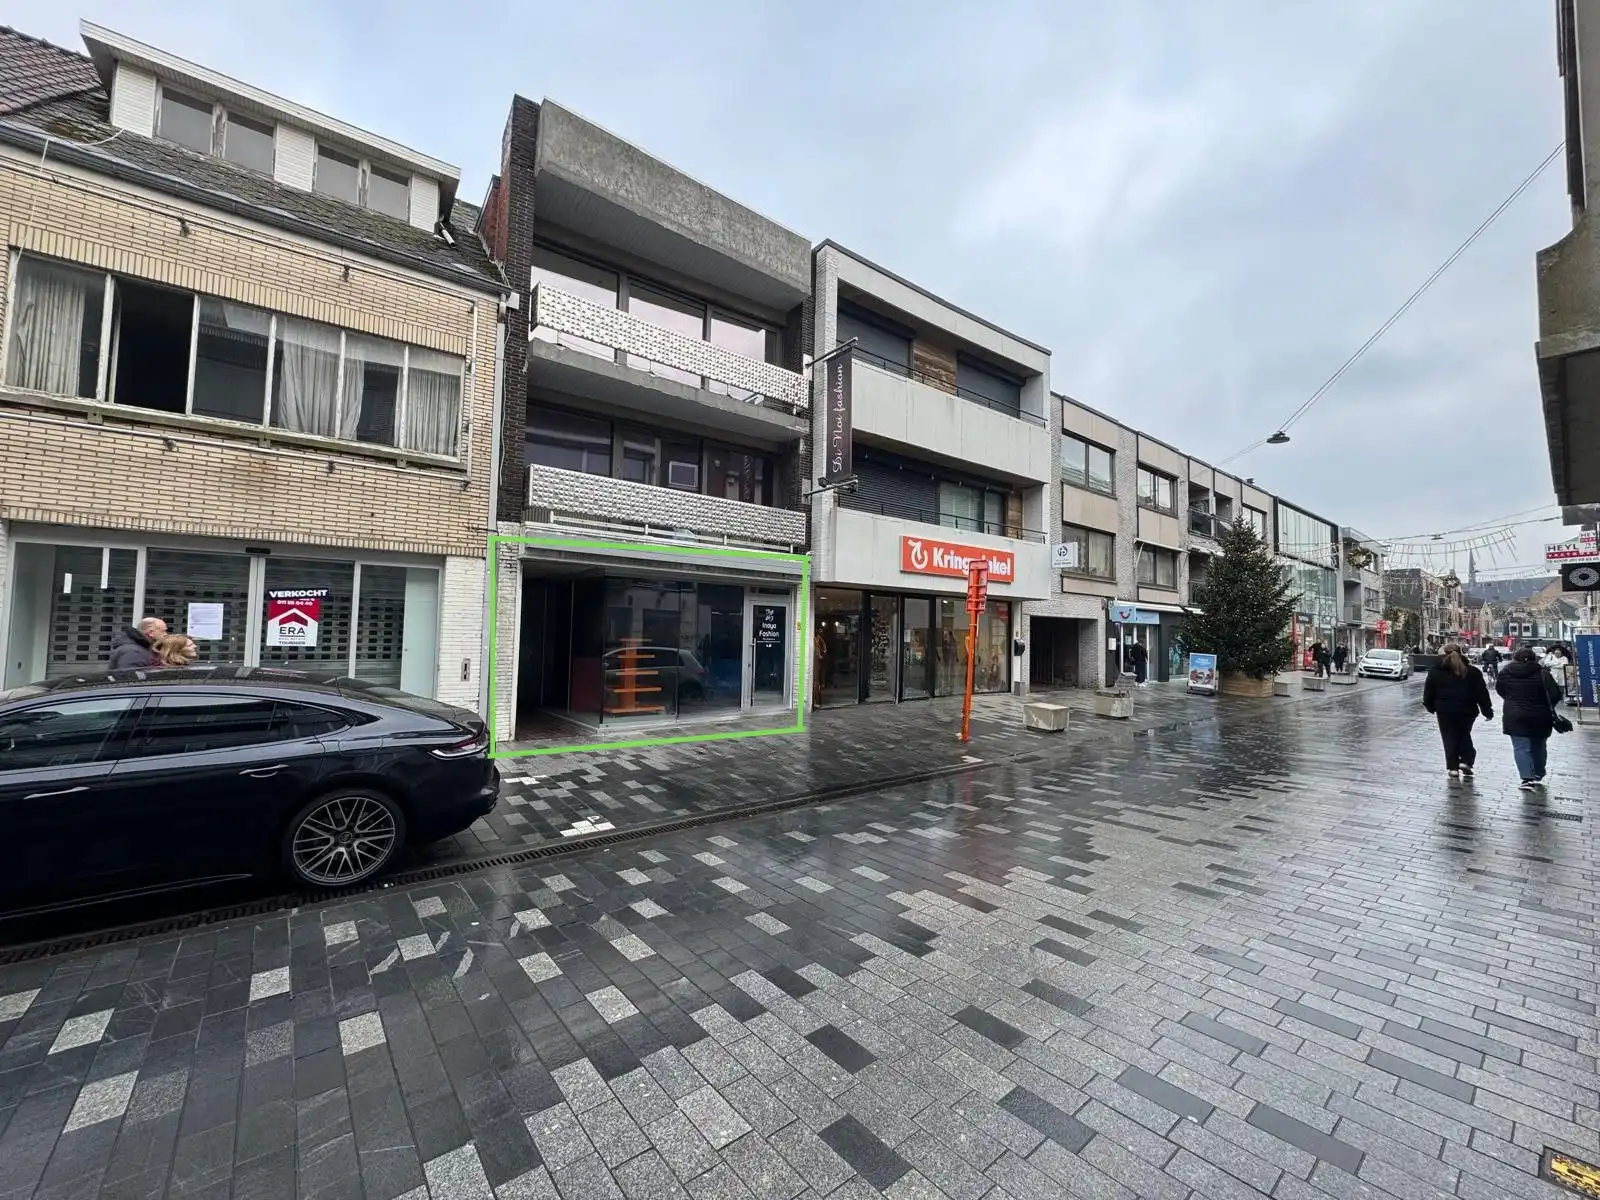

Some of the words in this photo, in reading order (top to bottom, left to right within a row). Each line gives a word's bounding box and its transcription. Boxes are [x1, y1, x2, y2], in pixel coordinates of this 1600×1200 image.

[833, 363, 847, 412] fashion
[832, 413, 843, 448] Noi
[1547, 543, 1580, 552] HEYL
[932, 546, 1011, 576] Kringnkel
[269, 589, 328, 598] VERKOCHT
[279, 626, 306, 635] ERA
[758, 630, 780, 638] Fashion
